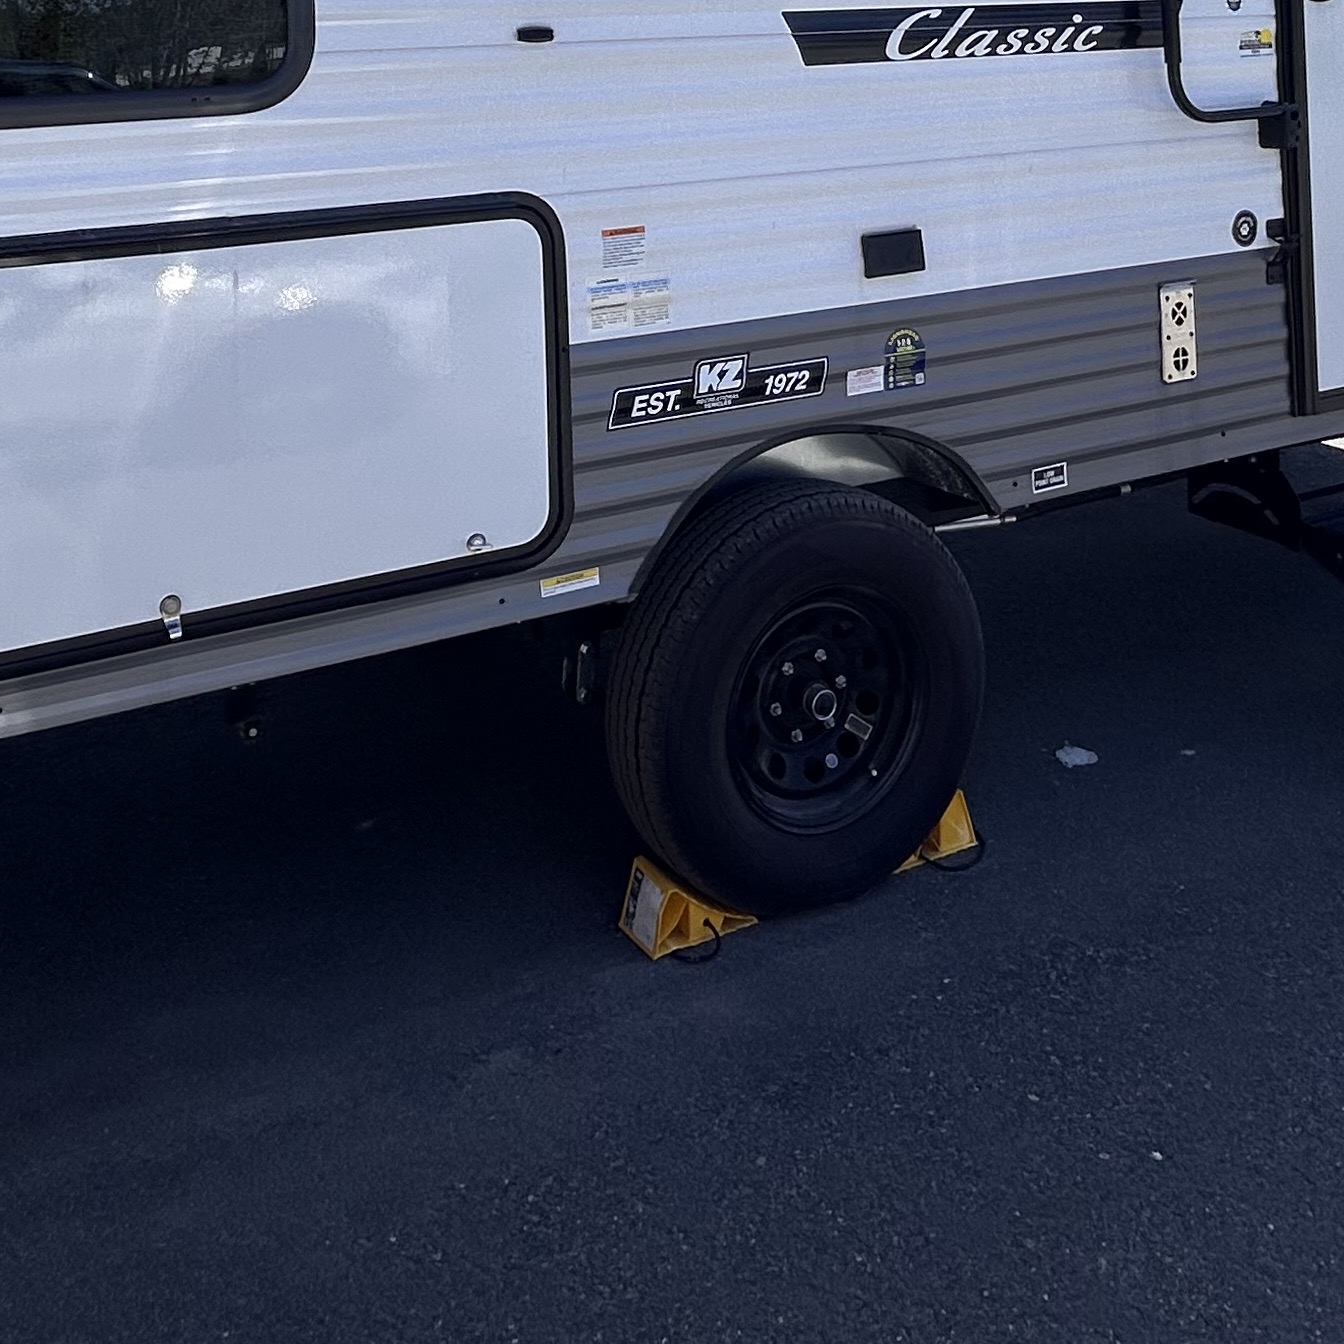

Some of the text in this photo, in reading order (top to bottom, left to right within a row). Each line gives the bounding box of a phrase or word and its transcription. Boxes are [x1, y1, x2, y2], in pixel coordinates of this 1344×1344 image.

[884, 7, 1104, 62] Classic
[630, 359, 810, 418] EST. KZ 1972
